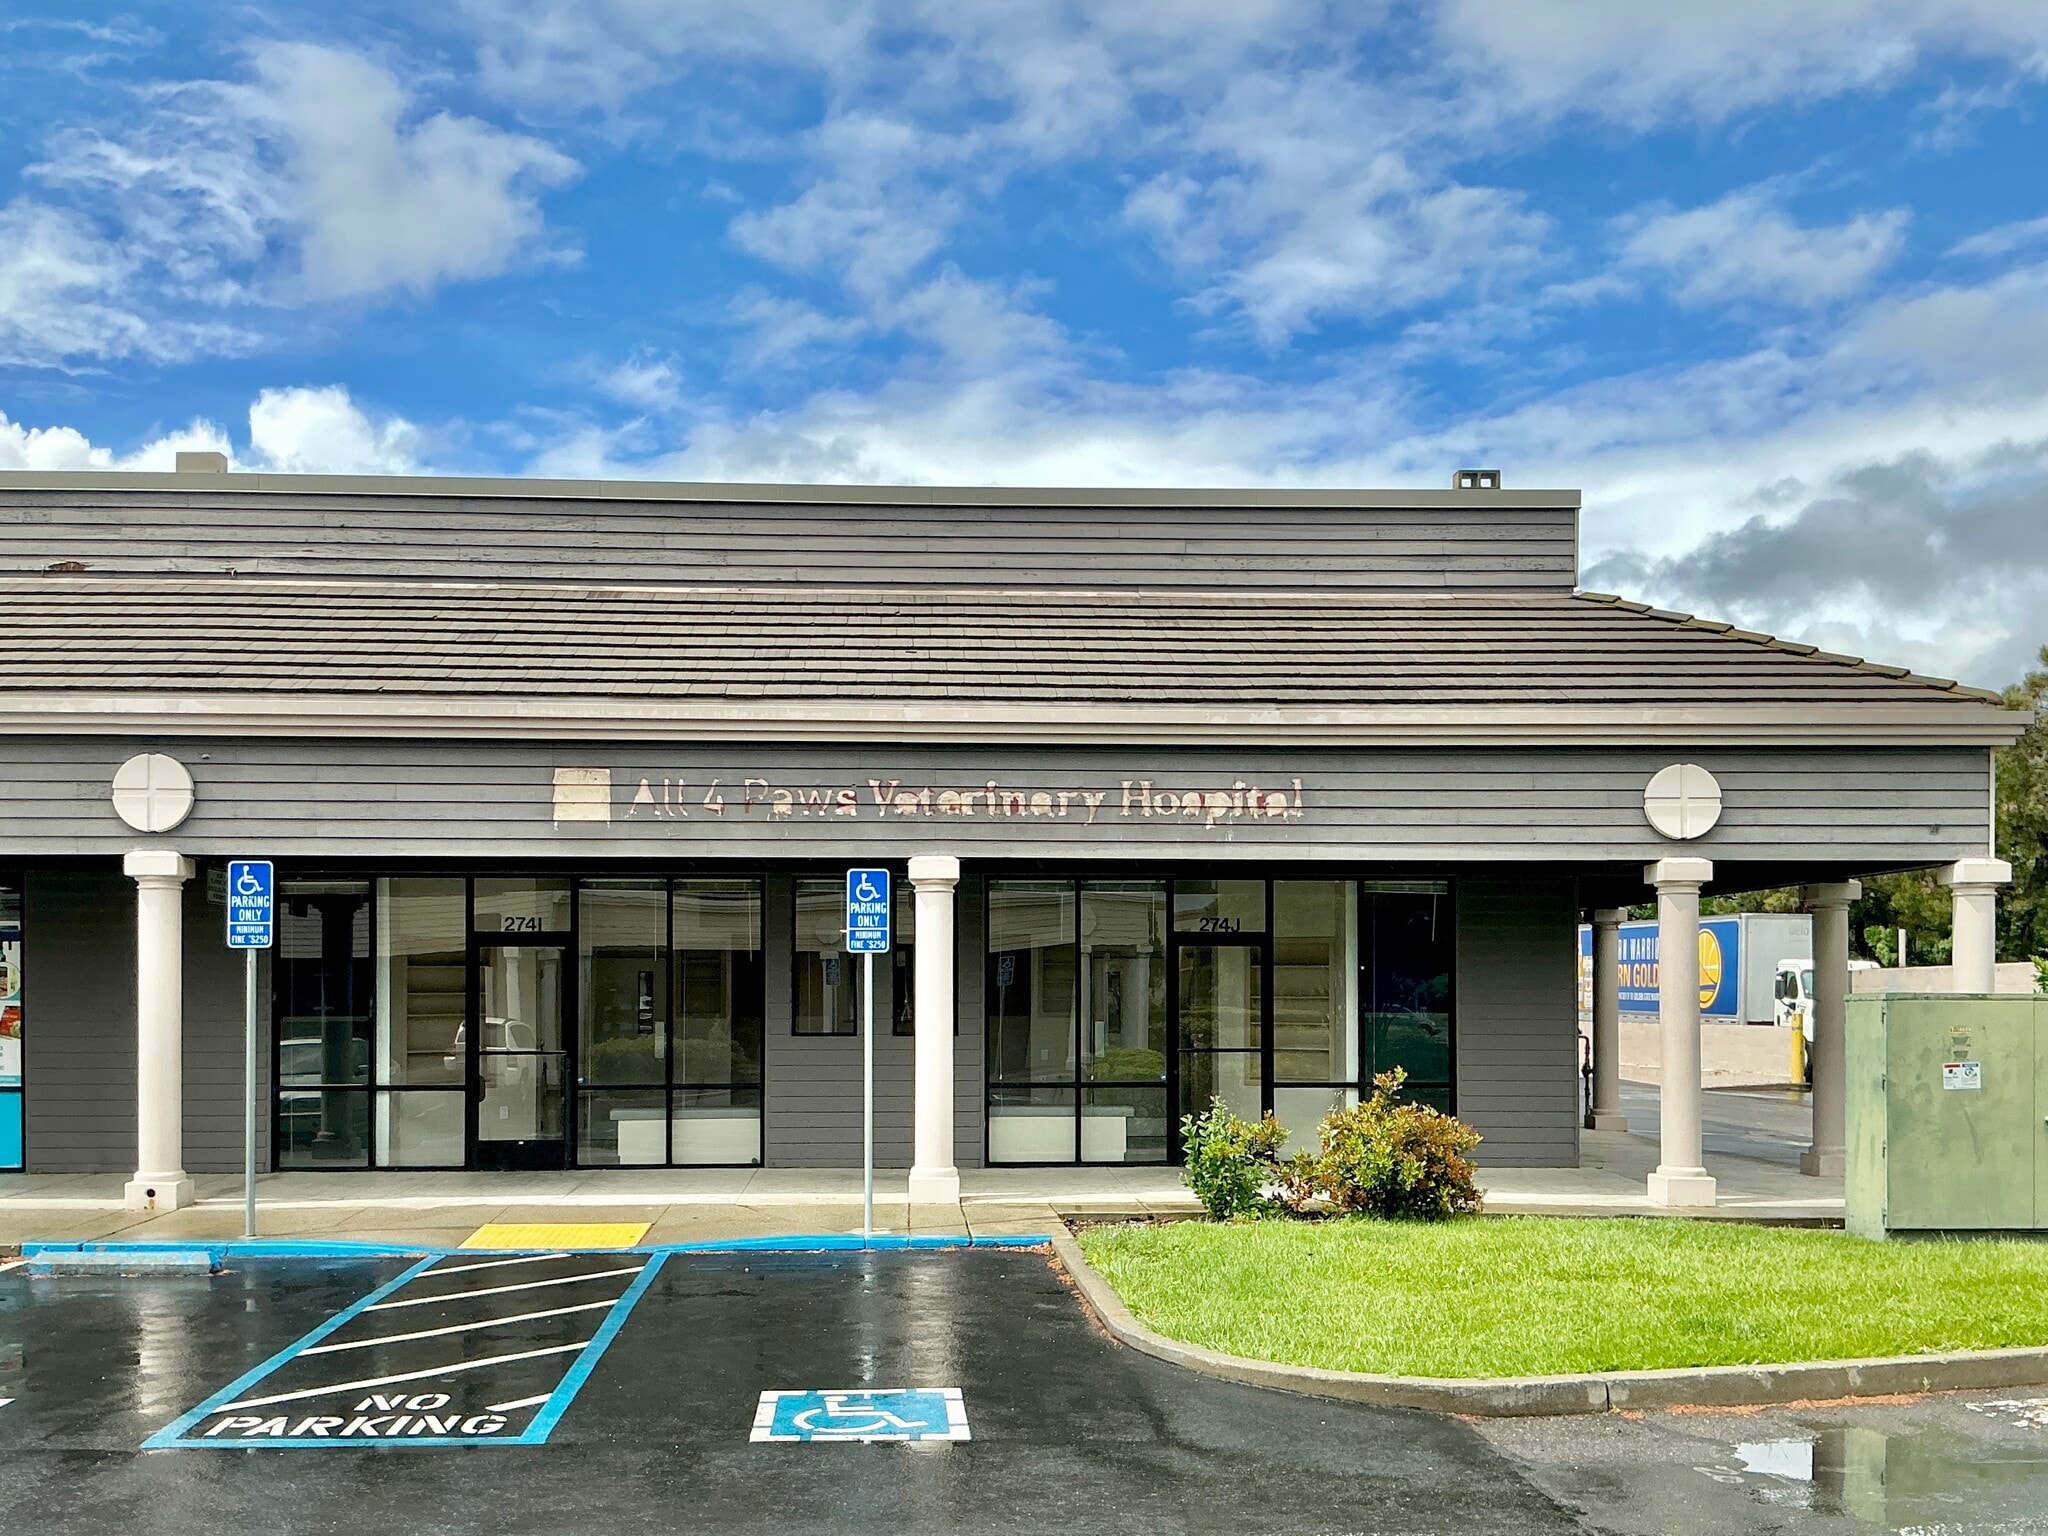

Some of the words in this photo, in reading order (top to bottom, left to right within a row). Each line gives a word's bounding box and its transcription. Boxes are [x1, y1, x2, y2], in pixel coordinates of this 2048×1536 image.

[629, 778, 688, 817] All
[703, 778, 724, 817] 4
[744, 778, 857, 817] Paws
[867, 778, 1106, 826] Veterinary
[1119, 777, 1304, 830] Hospital
[231, 895, 270, 908] PARKING
[850, 902, 887, 914] PARKING
[238, 909, 263, 922] ONLY
[857, 915, 880, 927] ONLY
[236, 925, 264, 934] MINIMUM
[1199, 917, 1240, 932] 274J
[231, 935, 246, 944] FINE
[855, 931, 882, 939] MINIMUM
[850, 940, 864, 949] FINE
[353, 1393, 452, 1412] NO
[203, 1414, 509, 1437] PARKING
